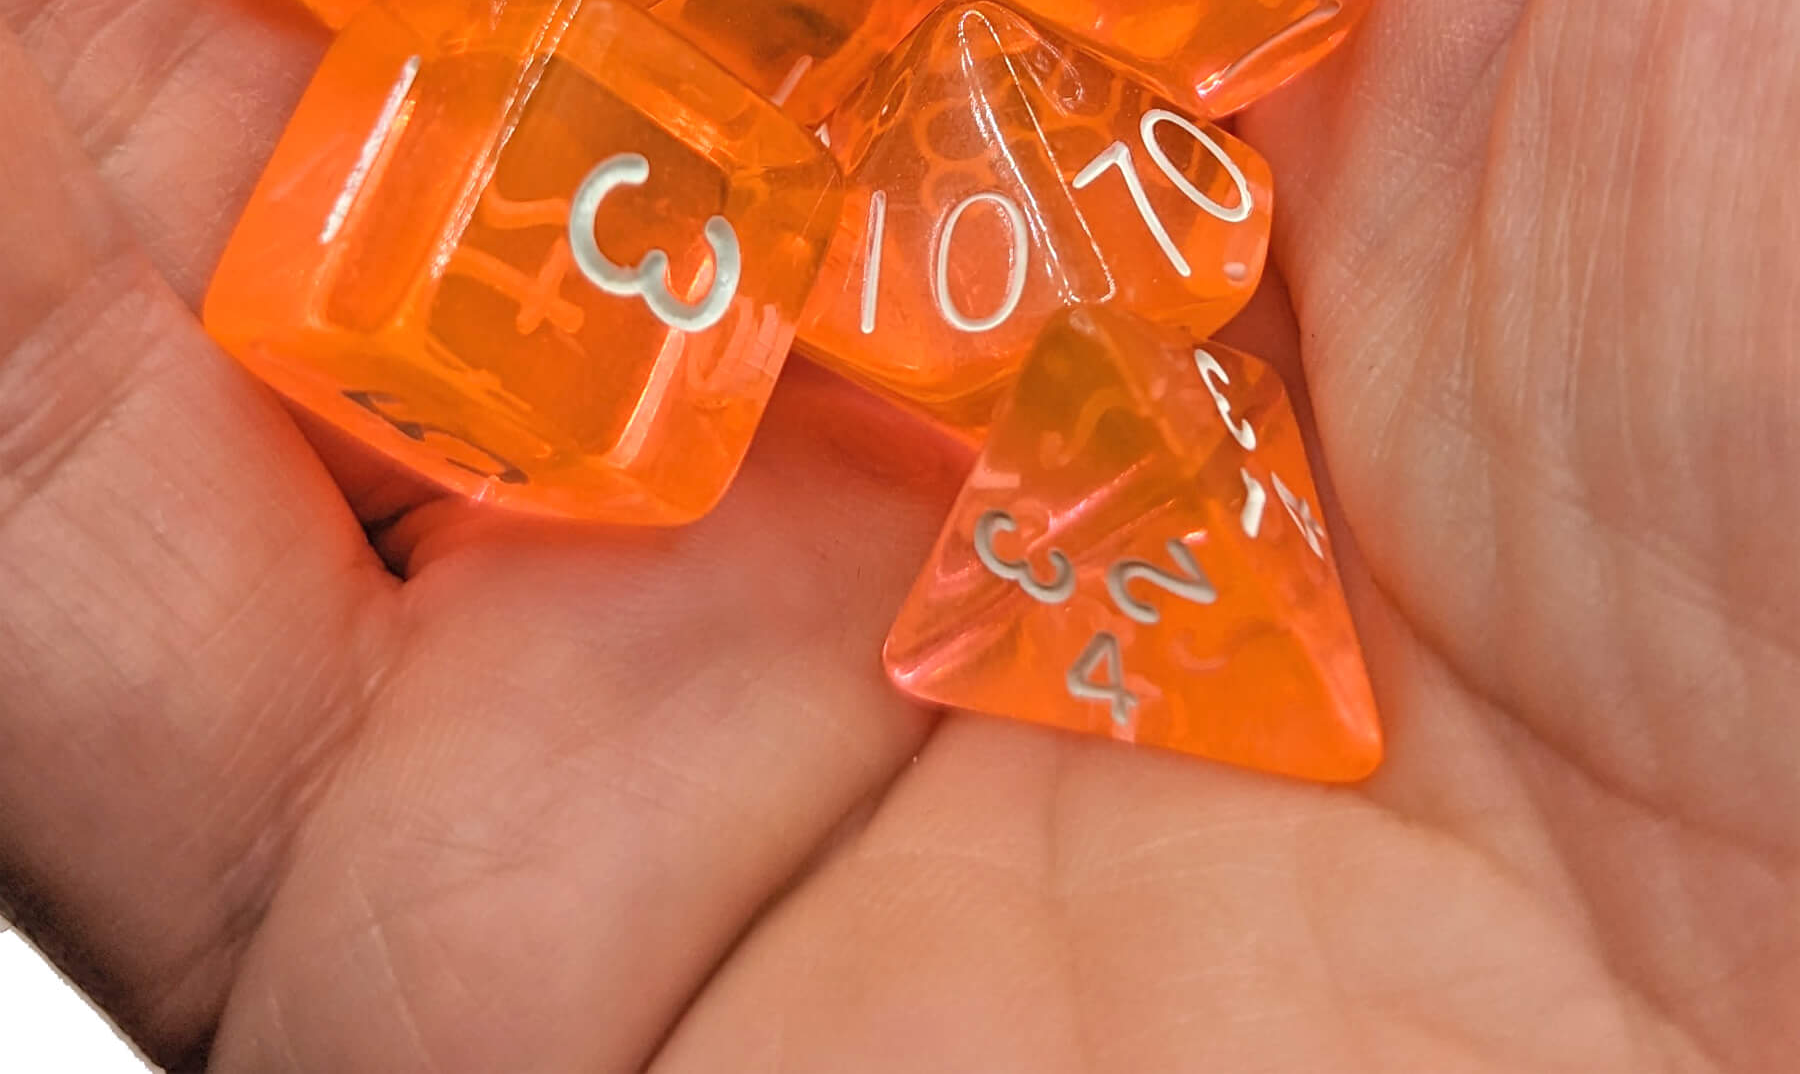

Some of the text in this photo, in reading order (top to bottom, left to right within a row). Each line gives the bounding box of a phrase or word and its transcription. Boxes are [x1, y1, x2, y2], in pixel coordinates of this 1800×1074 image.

[568, 151, 742, 332] 3
[1072, 108, 1254, 278] 70
[860, 189, 1029, 334] 10
[1193, 348, 1257, 452] 3
[973, 509, 1076, 604] 3
[1106, 538, 1219, 625] 2
[1065, 630, 1140, 727] 4
